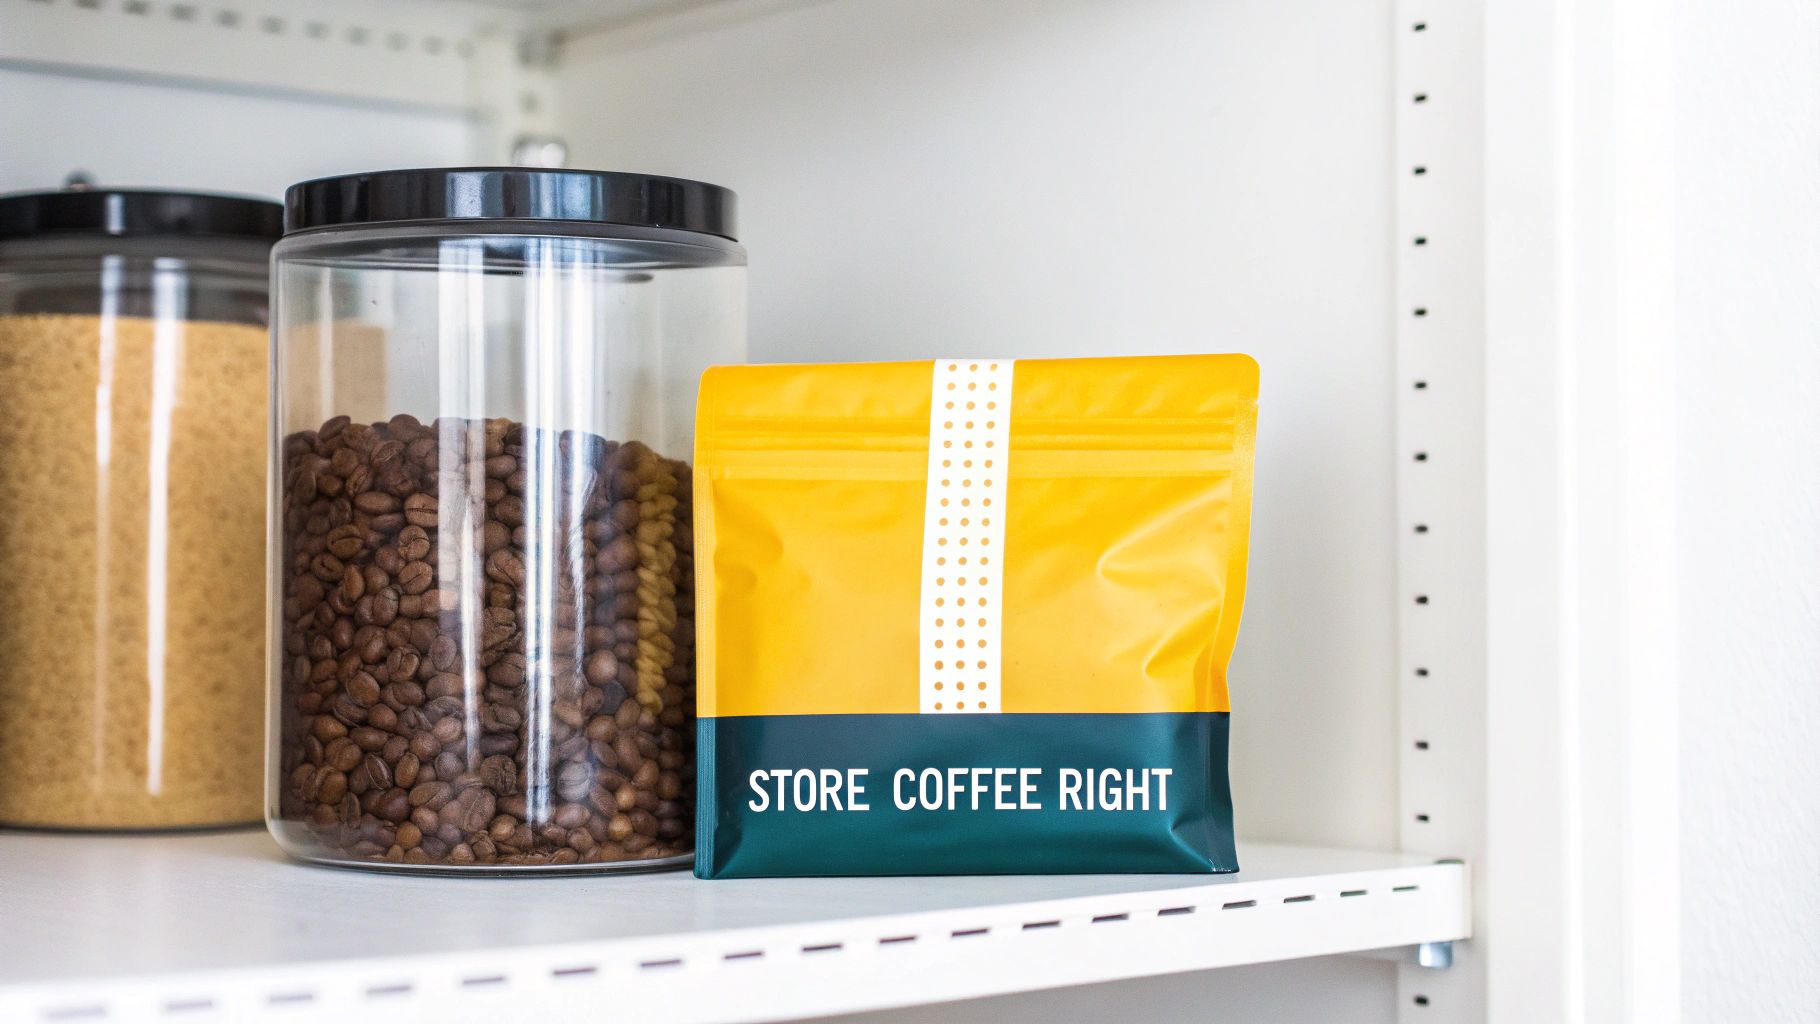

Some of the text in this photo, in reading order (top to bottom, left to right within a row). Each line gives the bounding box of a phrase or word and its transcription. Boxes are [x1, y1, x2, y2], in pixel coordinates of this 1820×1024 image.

[748, 767, 1173, 812] STORE COFFEE RIGHT
